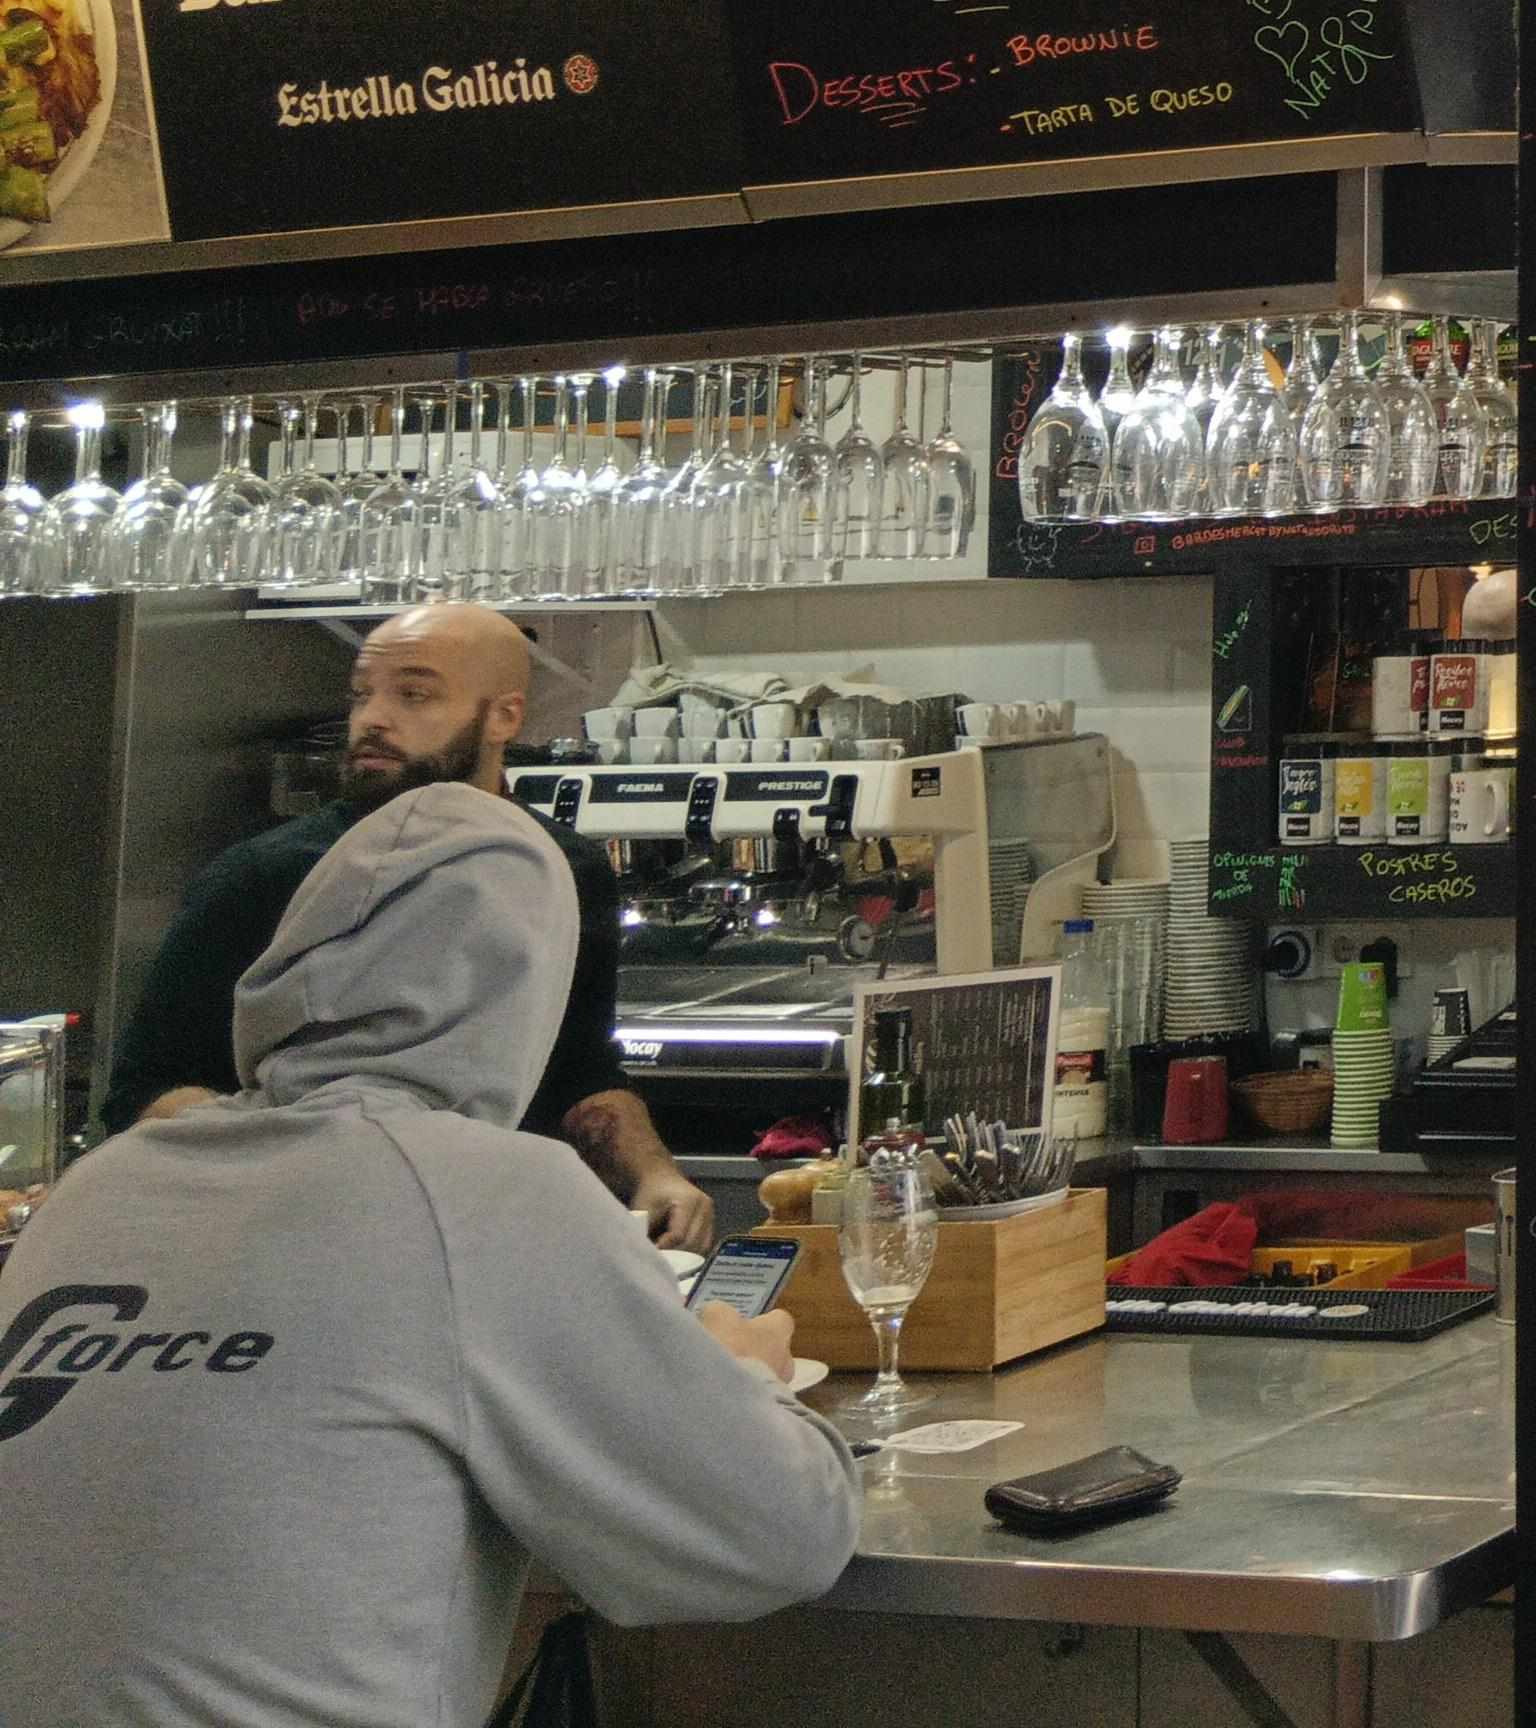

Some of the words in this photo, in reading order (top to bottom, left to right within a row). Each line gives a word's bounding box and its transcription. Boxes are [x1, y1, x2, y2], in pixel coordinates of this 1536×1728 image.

[276, 72, 417, 127] Estrella
[421, 57, 556, 112] Galicia
[1105, 95, 1140, 120] DE
[1149, 82, 1234, 115] QUESO
[616, 782, 665, 794] FAEMA
[757, 780, 824, 792] PRESTIGE
[1358, 851, 1459, 880] POSTRES
[1388, 875, 1478, 905] CASEROS
